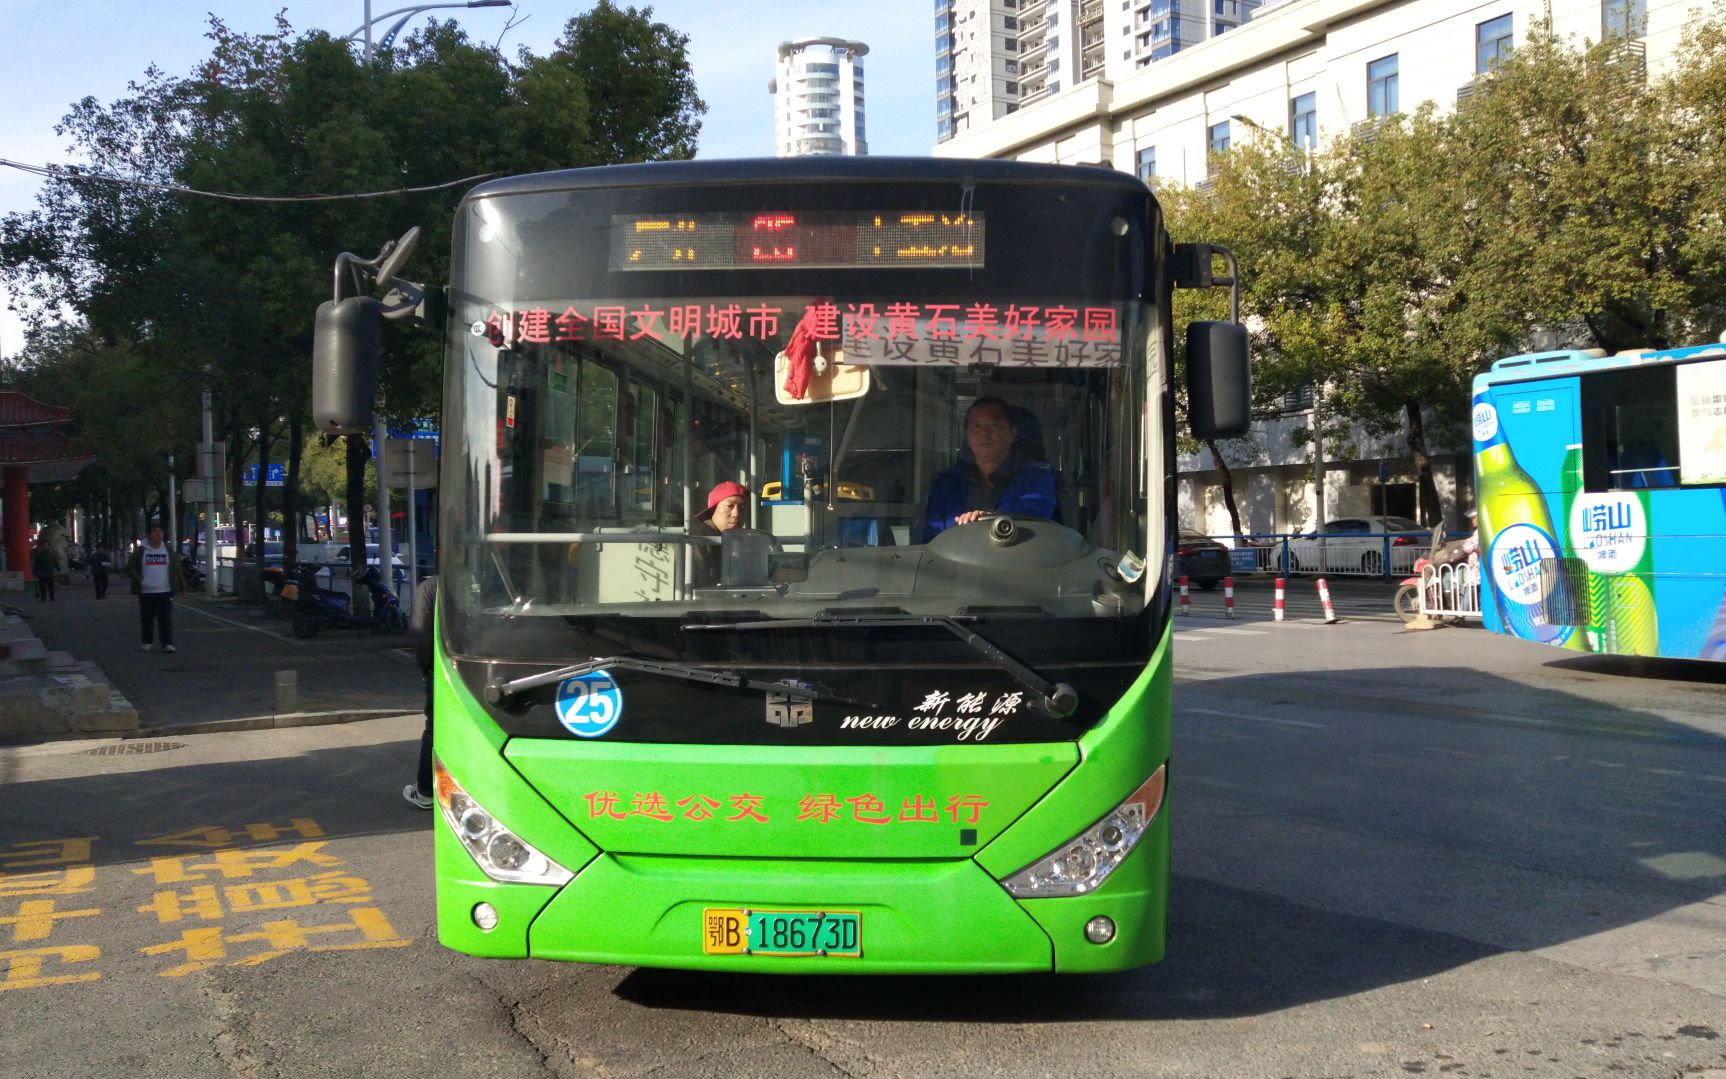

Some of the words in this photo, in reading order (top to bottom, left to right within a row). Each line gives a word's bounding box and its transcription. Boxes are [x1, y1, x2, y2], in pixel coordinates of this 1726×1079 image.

[487, 303, 782, 345] 创建全国文明城市
[804, 302, 1119, 342] 建设黄石美好家园
[565, 680, 614, 724] 25
[913, 690, 1023, 716] 新能源
[840, 715, 901, 729] new
[908, 713, 1004, 741] energy
[584, 791, 769, 824] 优选公交
[797, 793, 990, 825] 绿色出行
